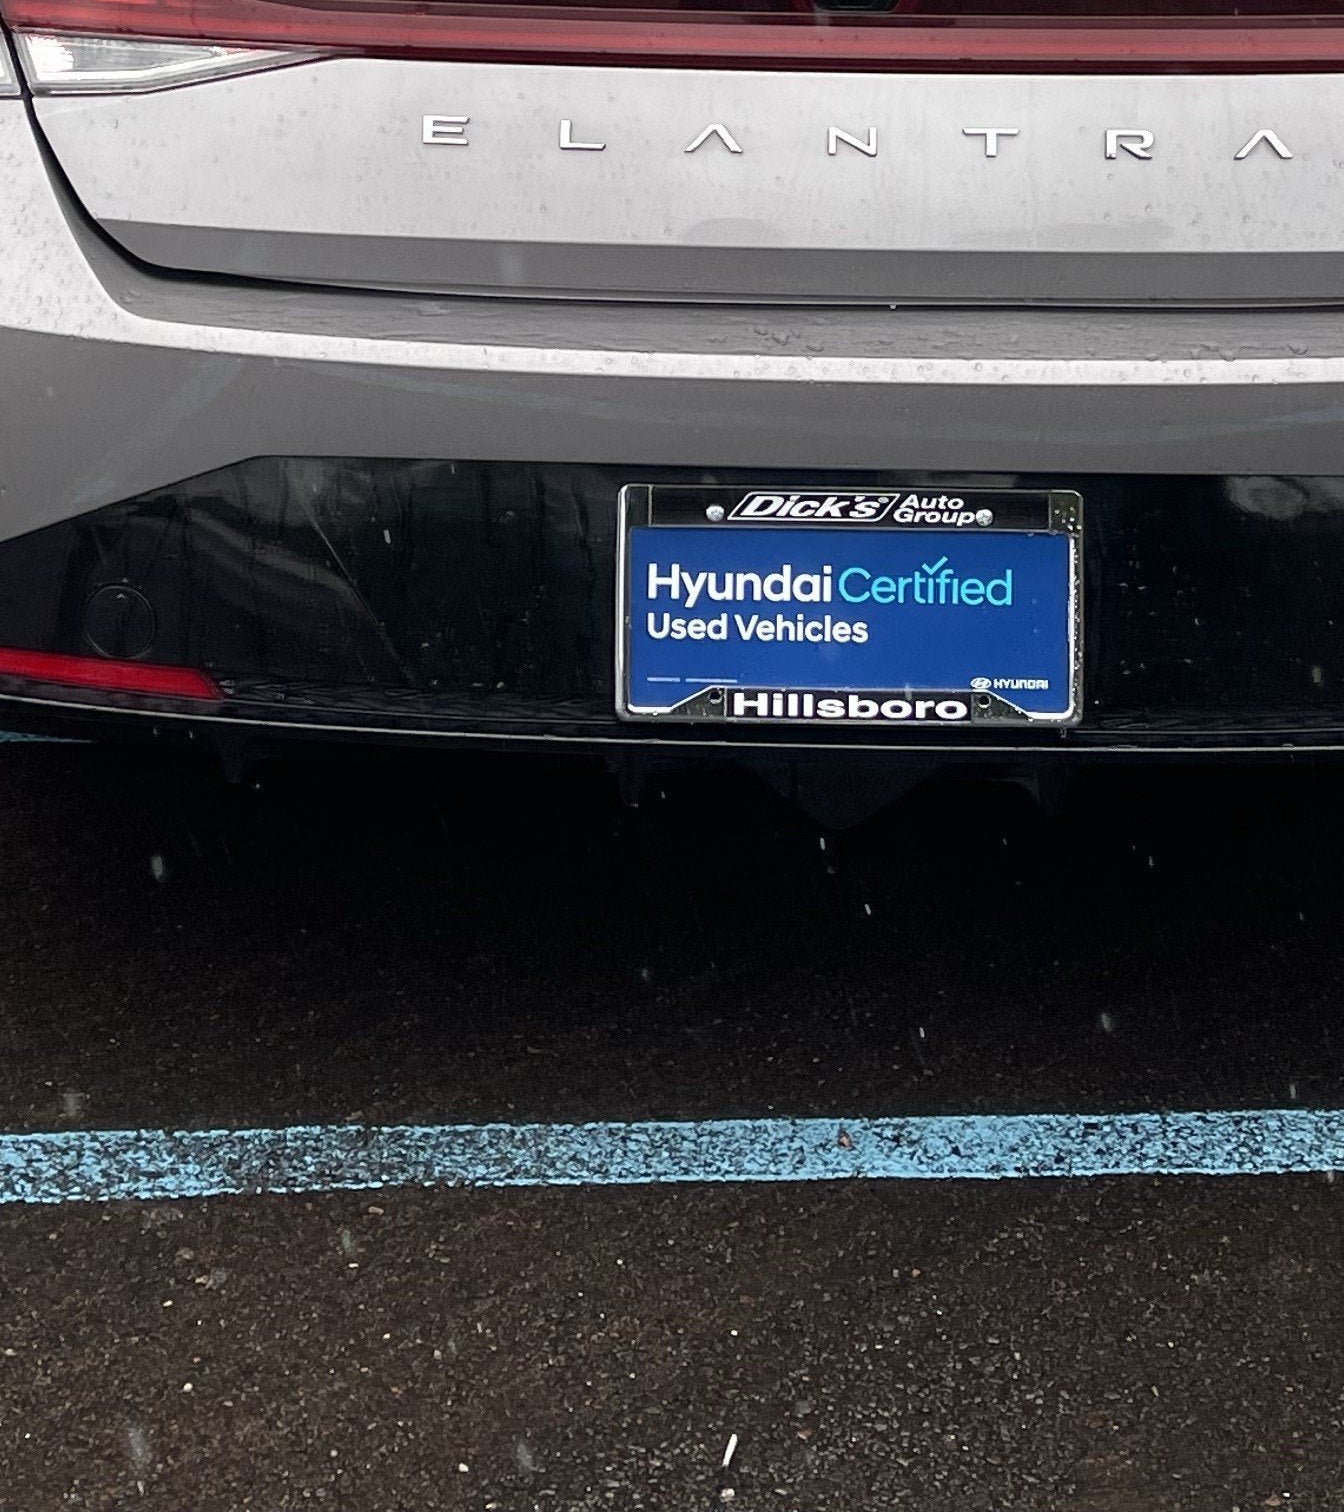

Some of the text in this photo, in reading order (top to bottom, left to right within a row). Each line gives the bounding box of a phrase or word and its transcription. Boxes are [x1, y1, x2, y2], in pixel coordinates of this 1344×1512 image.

[422, 114, 1294, 160] ELANTRA
[903, 494, 965, 510] Auto
[892, 508, 976, 527] Group
[647, 555, 1013, 608] Hyundai Certified
[647, 612, 869, 643] Used Vehicles
[993, 678, 1049, 689] HYUNDAI
[733, 693, 968, 720] Hillsboro
